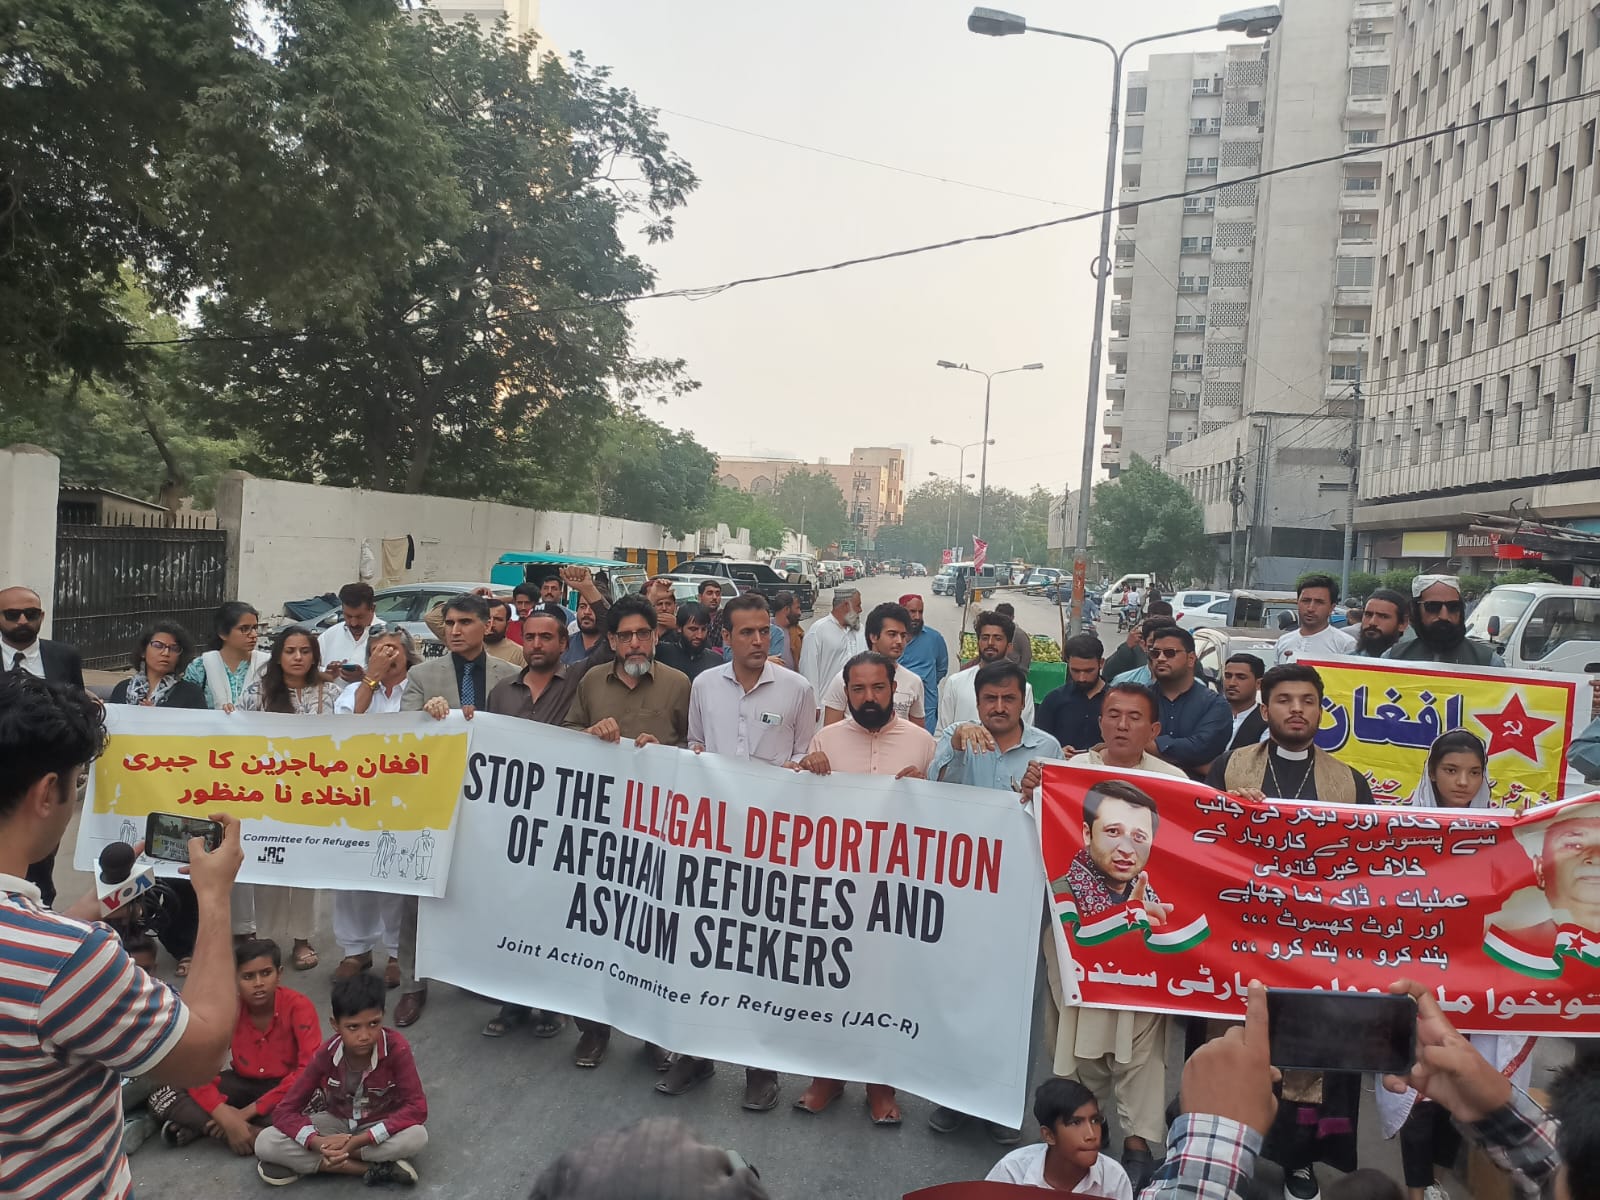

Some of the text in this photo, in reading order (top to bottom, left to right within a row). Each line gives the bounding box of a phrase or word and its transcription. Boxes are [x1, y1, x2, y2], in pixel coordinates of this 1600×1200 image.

[1314, 684, 1464, 751] افغان
[122, 750, 428, 778] افغان مہاجرین کا جبری
[178, 782, 371, 807] انخلاء نا منظور
[1195, 795, 1245, 819] جانب
[463, 752, 545, 810] STOP
[555, 767, 615, 825] THE
[744, 806, 1003, 894] DEPORTATION
[1344, 812, 1379, 829] اور
[243, 833, 370, 848] Committee for Refugees
[1193, 823, 1227, 843] کے
[1235, 827, 1306, 851] کاروبار
[1313, 838, 1349, 857] کے
[1451, 835, 1496, 855] سے
[507, 814, 945, 944] OF AFGHAN REFUGEES AND
[1254, 856, 1426, 880] خلاف غیر قانونی
[102, 874, 153, 911] VOA
[1218, 880, 1286, 907] چھاپے
[1292, 885, 1322, 903] نما
[1330, 884, 1370, 906] ڈاکہ
[1396, 889, 1469, 912] عملیات
[1277, 909, 1354, 935] کھسوٹ
[1361, 916, 1403, 938] لوٹ
[1409, 919, 1445, 939] اور
[565, 881, 853, 989] ASYLUM SEEKERS
[1266, 938, 1303, 960] کرو
[1311, 940, 1338, 962] بند
[1374, 945, 1411, 967] کرو
[1420, 946, 1448, 969] بند
[497, 936, 920, 1040] Joint Action Committee for Refugees (JAC-R)
